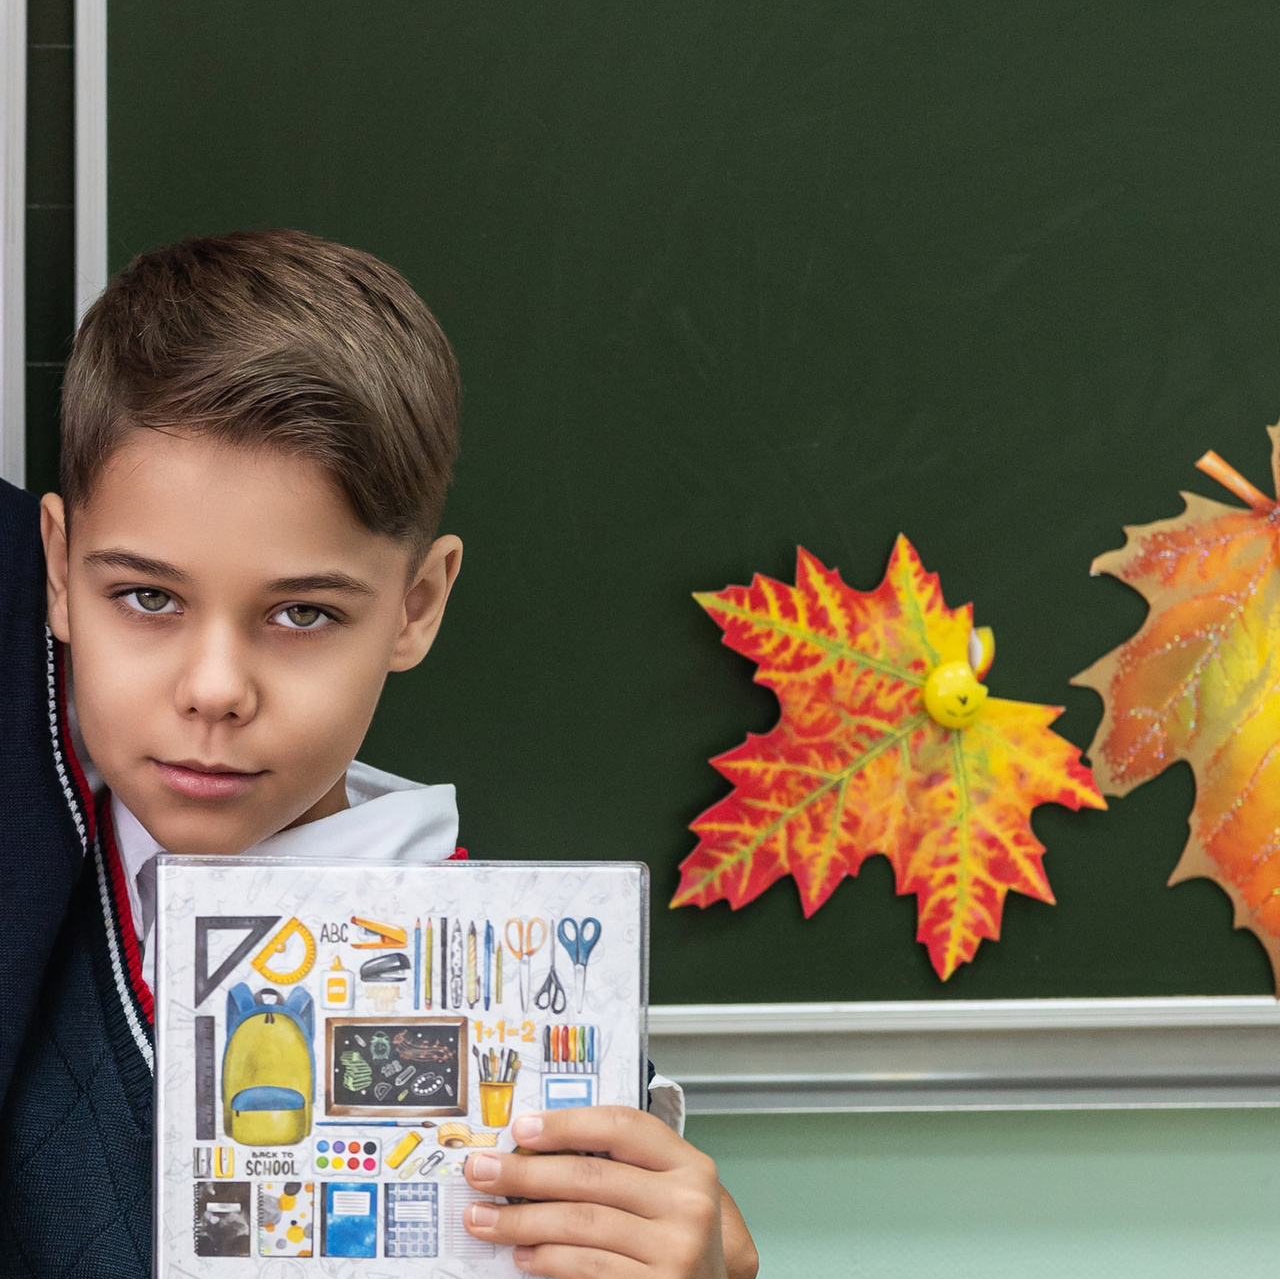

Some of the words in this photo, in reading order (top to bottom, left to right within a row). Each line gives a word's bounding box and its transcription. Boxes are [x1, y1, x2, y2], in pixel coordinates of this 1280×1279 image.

[320, 923, 348, 943] ABC
[473, 1020, 535, 1043] 1+1=2
[252, 1151, 277, 1159] BACK
[282, 1151, 294, 1159] TO
[246, 1160, 299, 1176] SCHOOL
